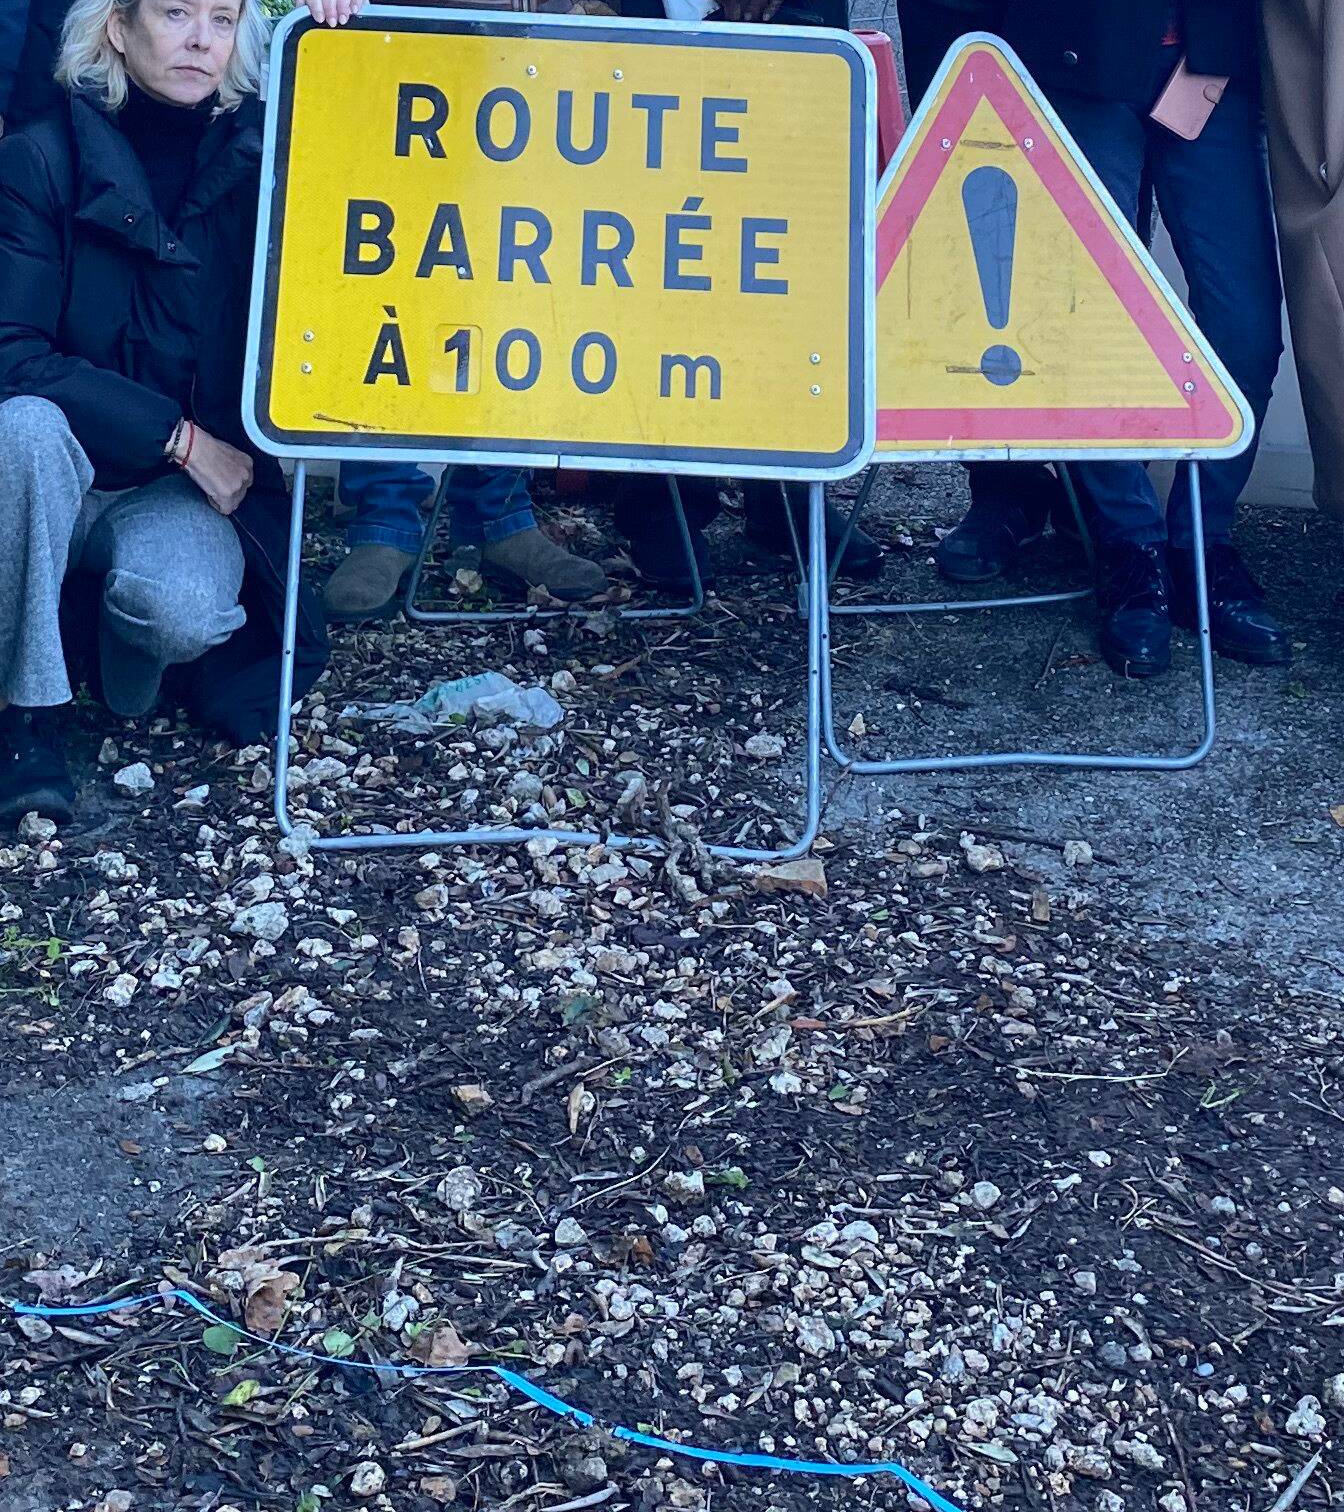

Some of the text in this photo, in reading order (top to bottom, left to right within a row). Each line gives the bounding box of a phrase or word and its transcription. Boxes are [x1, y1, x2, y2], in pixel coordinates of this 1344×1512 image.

[394, 82, 748, 174] ROUTE
[343, 196, 789, 295] BARRÉE
[363, 305, 722, 400] À 100 m
